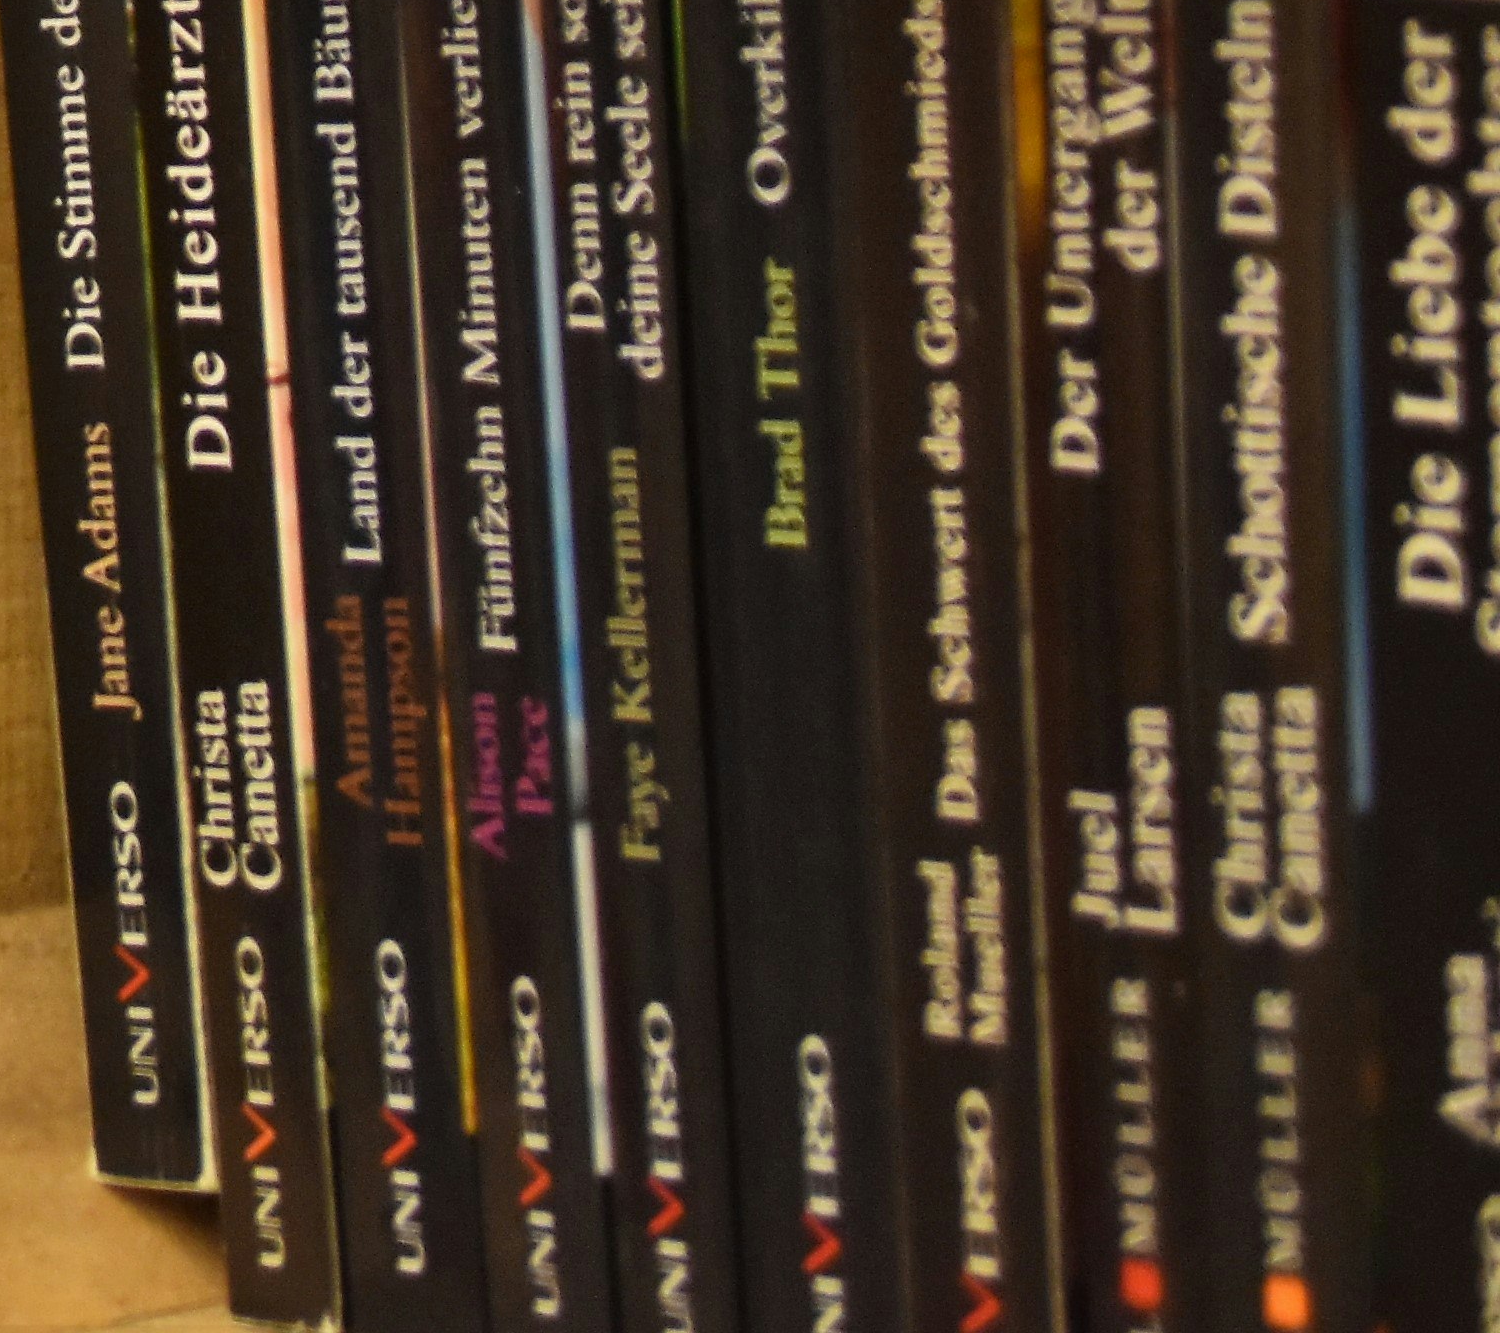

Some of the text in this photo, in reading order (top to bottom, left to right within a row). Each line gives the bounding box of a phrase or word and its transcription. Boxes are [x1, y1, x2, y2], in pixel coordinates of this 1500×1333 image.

[56, 64, 98, 261] Stimme
[558, 62, 596, 165] rein
[317, 122, 367, 315] tausend
[459, 158, 501, 384] Minuten
[565, 185, 606, 333] Denn
[1104, 160, 1162, 276] der
[64, 275, 106, 371] Die
[331, 332, 373, 419] der
[618, 232, 667, 381] deine
[759, 257, 800, 402] Thor
[1386, 18, 1466, 611] Die Liebe der
[186, 351, 232, 471] Die
[1051, 348, 1101, 477] Der
[77, 422, 144, 722] Jane Adams
[335, 437, 383, 565] Land
[608, 446, 651, 725] Kellerman
[194, 688, 239, 888] Christa
[237, 679, 283, 892] Canetta
[1124, 704, 1178, 935] Larsen
[235, 935, 285, 1271] UNIVERSO
